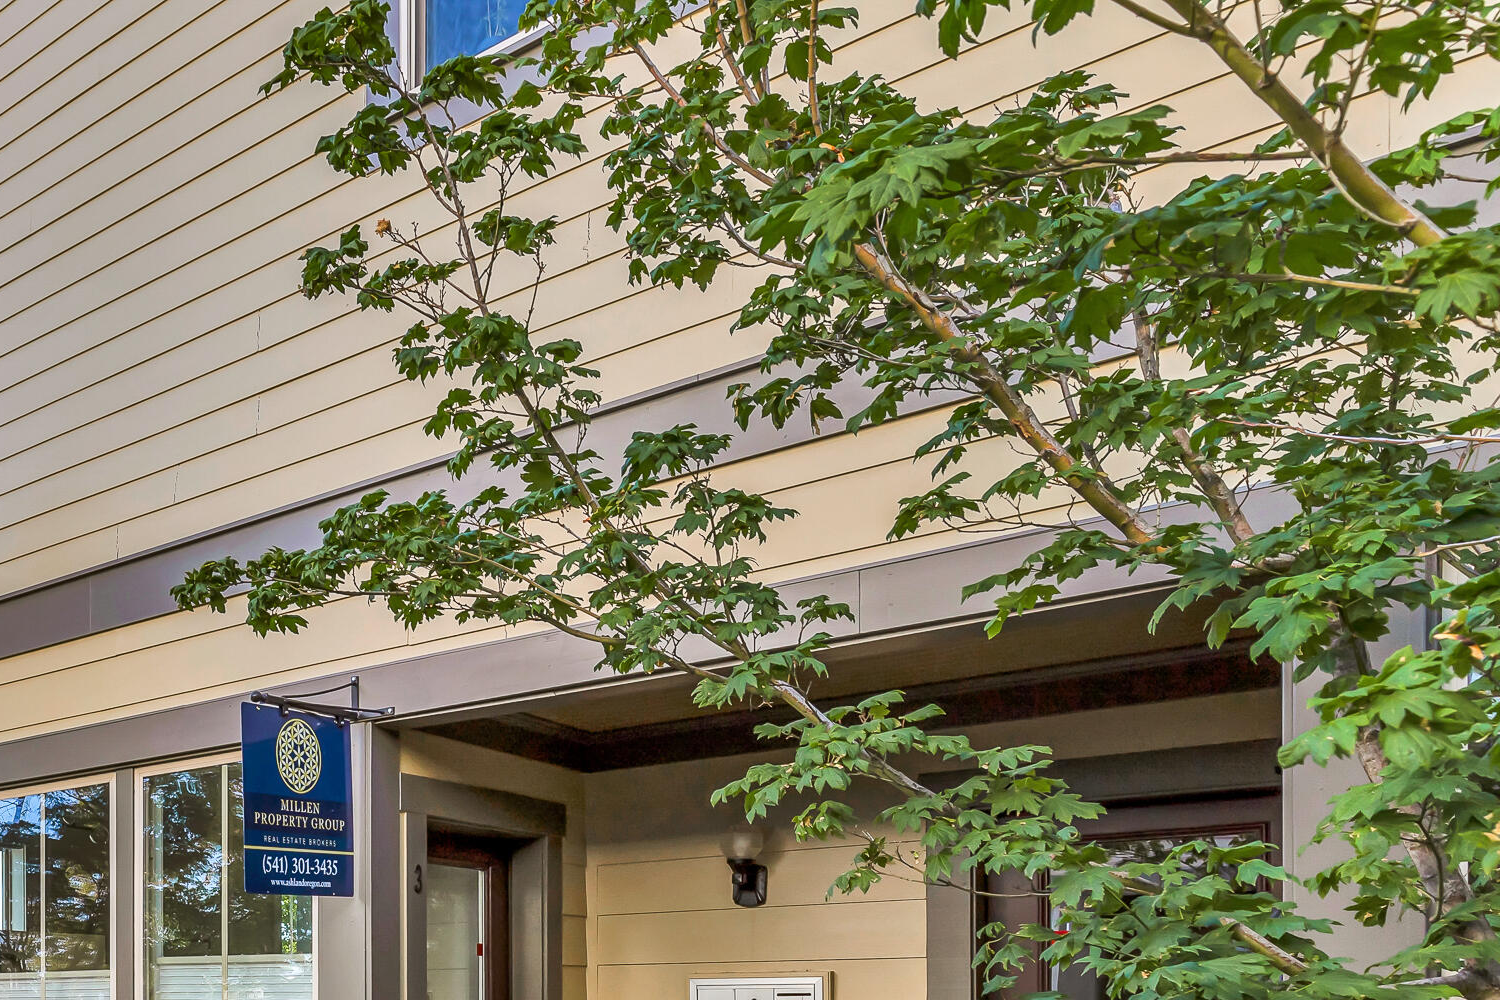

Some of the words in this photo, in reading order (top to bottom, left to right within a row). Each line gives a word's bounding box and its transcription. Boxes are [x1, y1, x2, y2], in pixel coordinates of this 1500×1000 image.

[280, 799, 320, 815] MILLEN
[254, 812, 308, 828] PROPERTY
[311, 818, 345, 831] GROUP
[263, 835, 280, 844] REAL
[282, 836, 306, 845] ESTATE
[308, 838, 337, 847] BROKERS
[262, 854, 288, 875] (541)
[291, 857, 338, 876] 301-3435
[413, 864, 423, 894] 3
